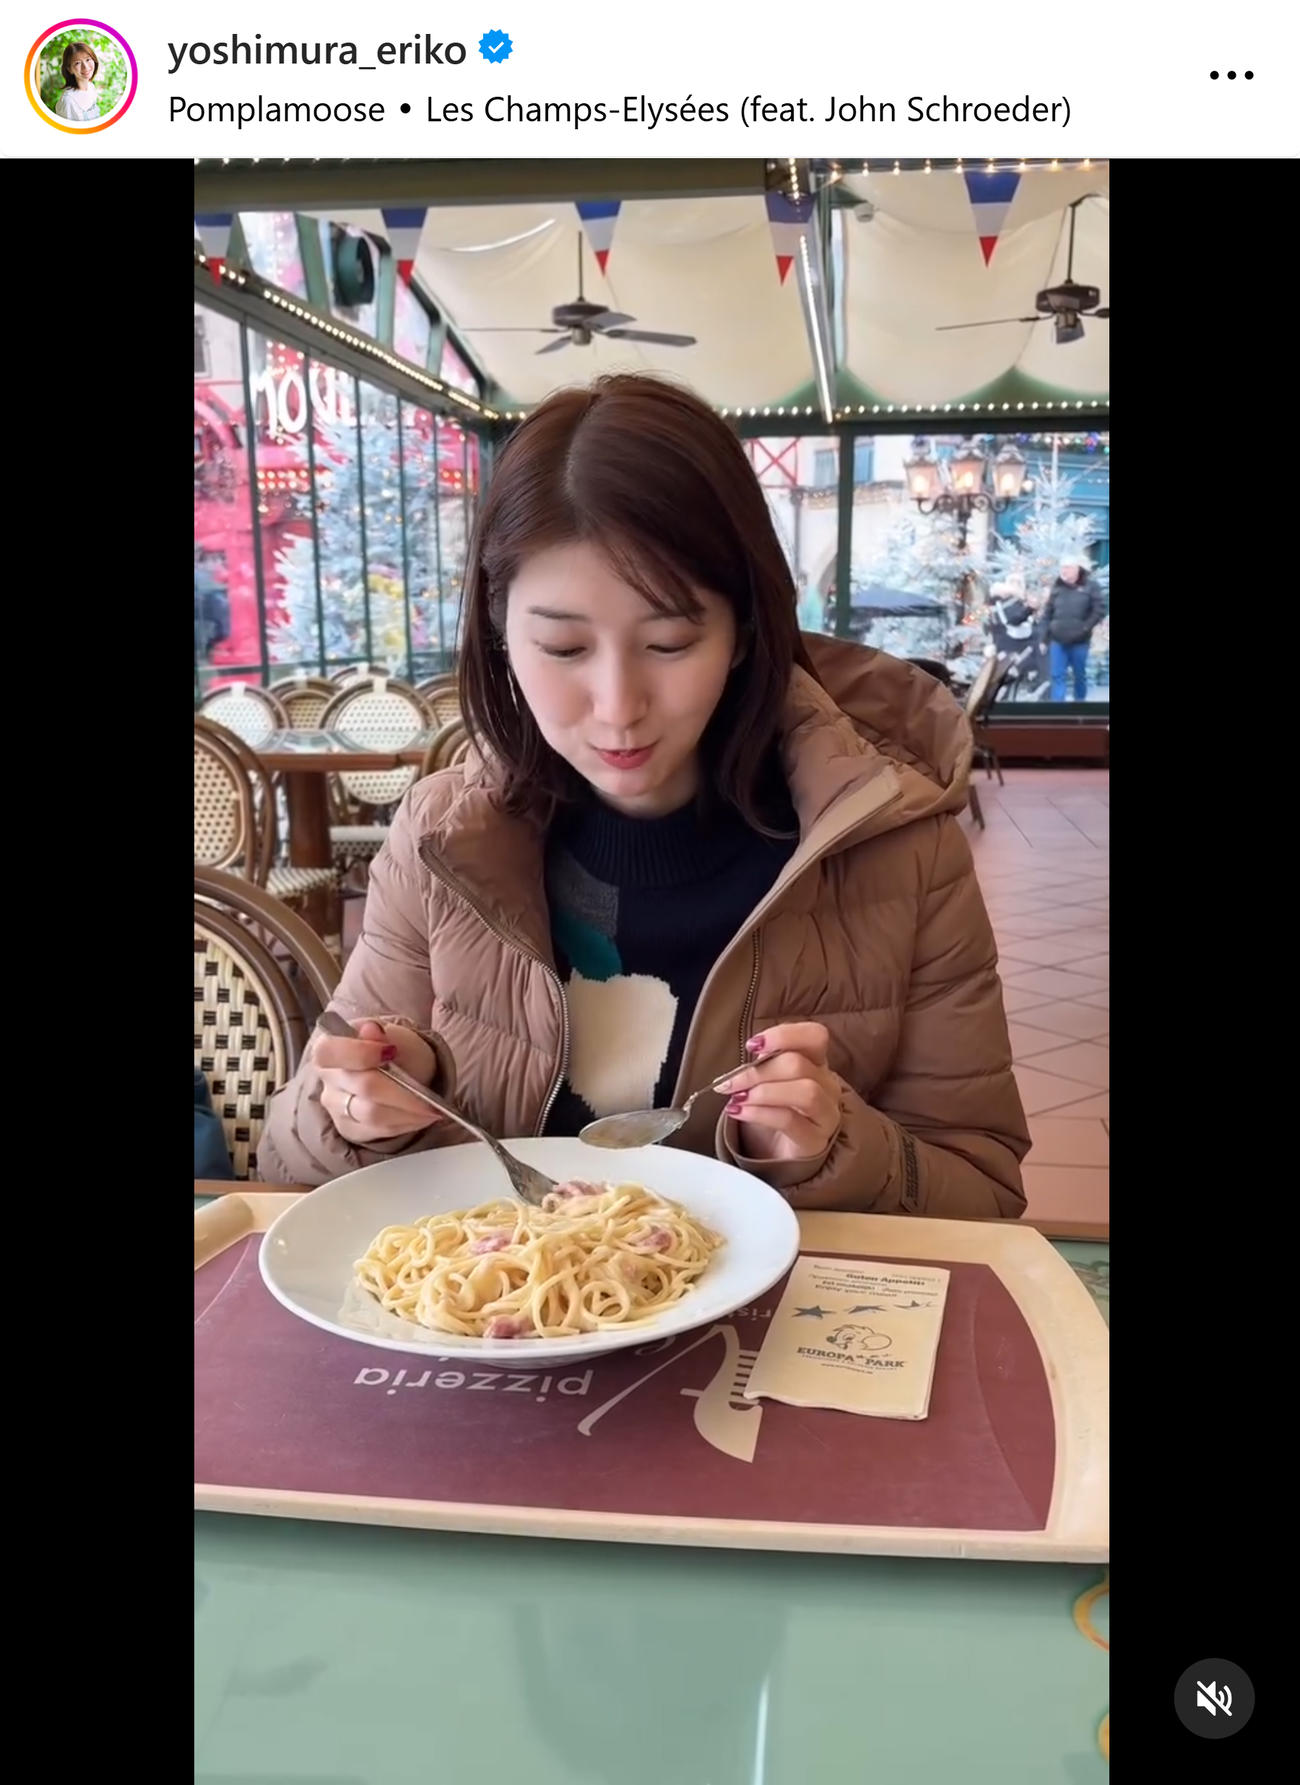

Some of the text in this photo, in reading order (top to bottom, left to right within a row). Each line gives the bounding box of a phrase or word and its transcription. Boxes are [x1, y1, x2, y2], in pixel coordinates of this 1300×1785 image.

[797, 1346, 855, 1362] EUROPA
[865, 1358, 905, 1368] PARK
[353, 1367, 595, 1402] pizzeria
